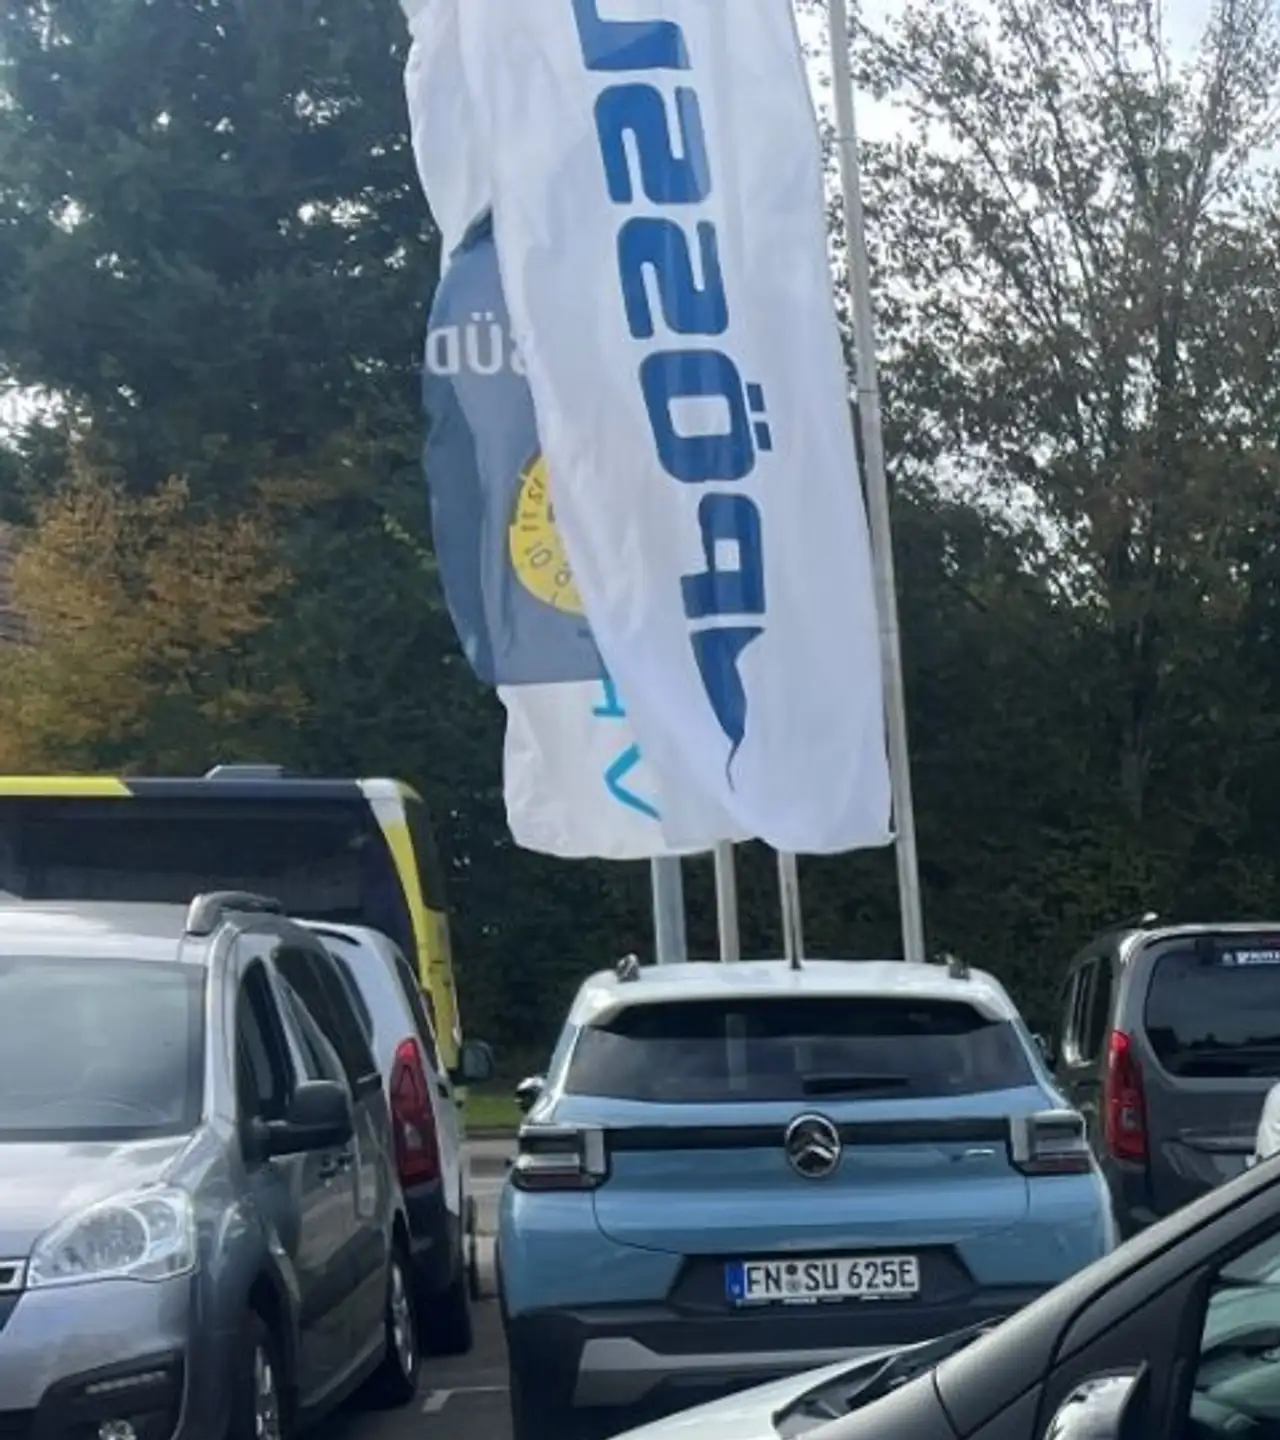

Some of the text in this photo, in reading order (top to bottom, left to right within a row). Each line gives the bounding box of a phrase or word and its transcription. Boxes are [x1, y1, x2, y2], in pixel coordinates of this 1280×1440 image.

[746, 1260, 916, 1294] FN SU 625E
